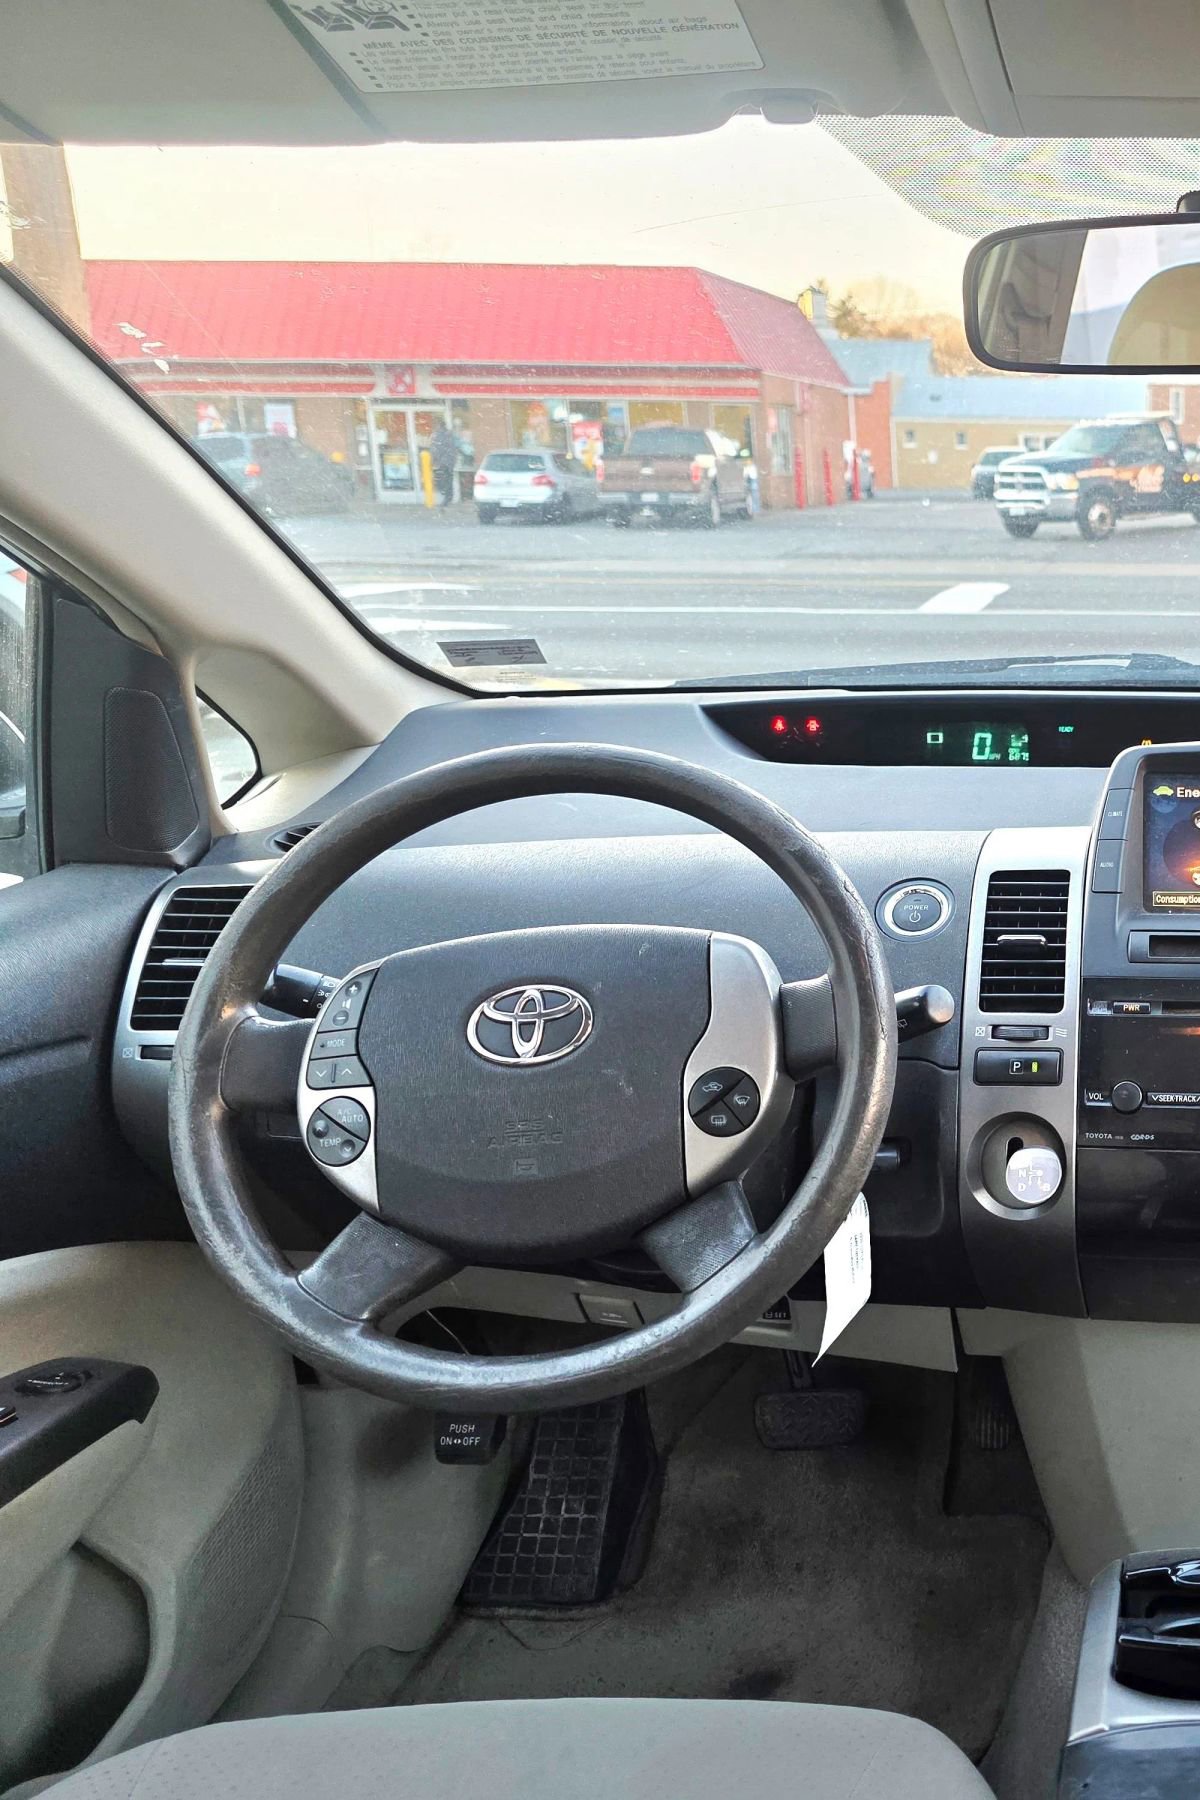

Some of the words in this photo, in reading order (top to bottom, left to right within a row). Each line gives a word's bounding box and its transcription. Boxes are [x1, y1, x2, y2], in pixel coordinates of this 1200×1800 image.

[400, 38, 428, 48] AVEC
[432, 37, 455, 47] DES
[459, 35, 513, 45] COUSSINS
[516, 33, 533, 42] DE
[592, 29, 608, 38] DE
[611, 26, 668, 37] NOUVELLE
[1123, 1004, 1141, 1012] PWR
[327, 1038, 347, 1048] MODE
[1012, 1061, 1022, 1073] P
[1088, 1092, 1104, 1101] VOL
[341, 1114, 364, 1123] AUTO
[319, 1138, 342, 1148] TEMP
[1018, 1168, 1027, 1178] N
[449, 1423, 475, 1434] PUSH
[440, 1436, 453, 1446] ON
[462, 1436, 481, 1446] OFF
